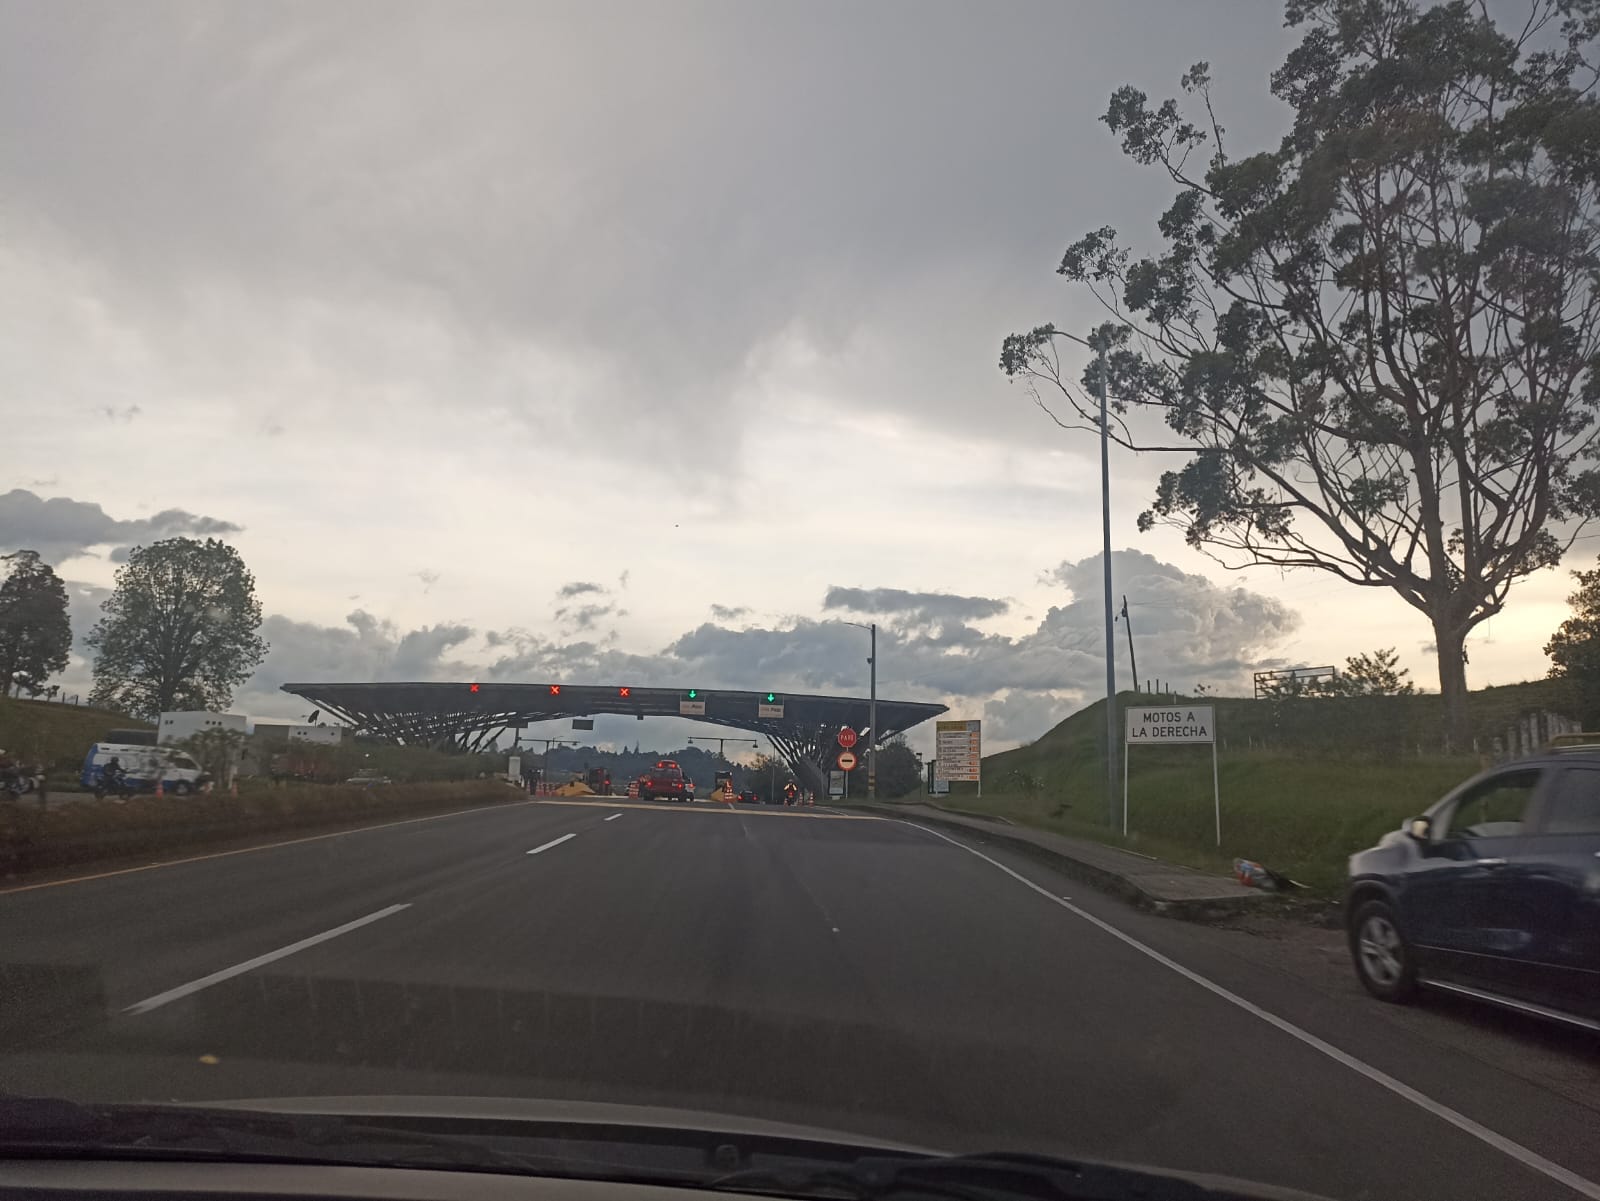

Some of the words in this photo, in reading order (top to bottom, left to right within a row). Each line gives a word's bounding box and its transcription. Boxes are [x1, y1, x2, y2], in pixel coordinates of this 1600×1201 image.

[1143, 712, 1181, 723] MOTOS
[1186, 711, 1195, 722] A
[1132, 727, 1148, 738] LA
[1152, 726, 1207, 737] DERECHA
